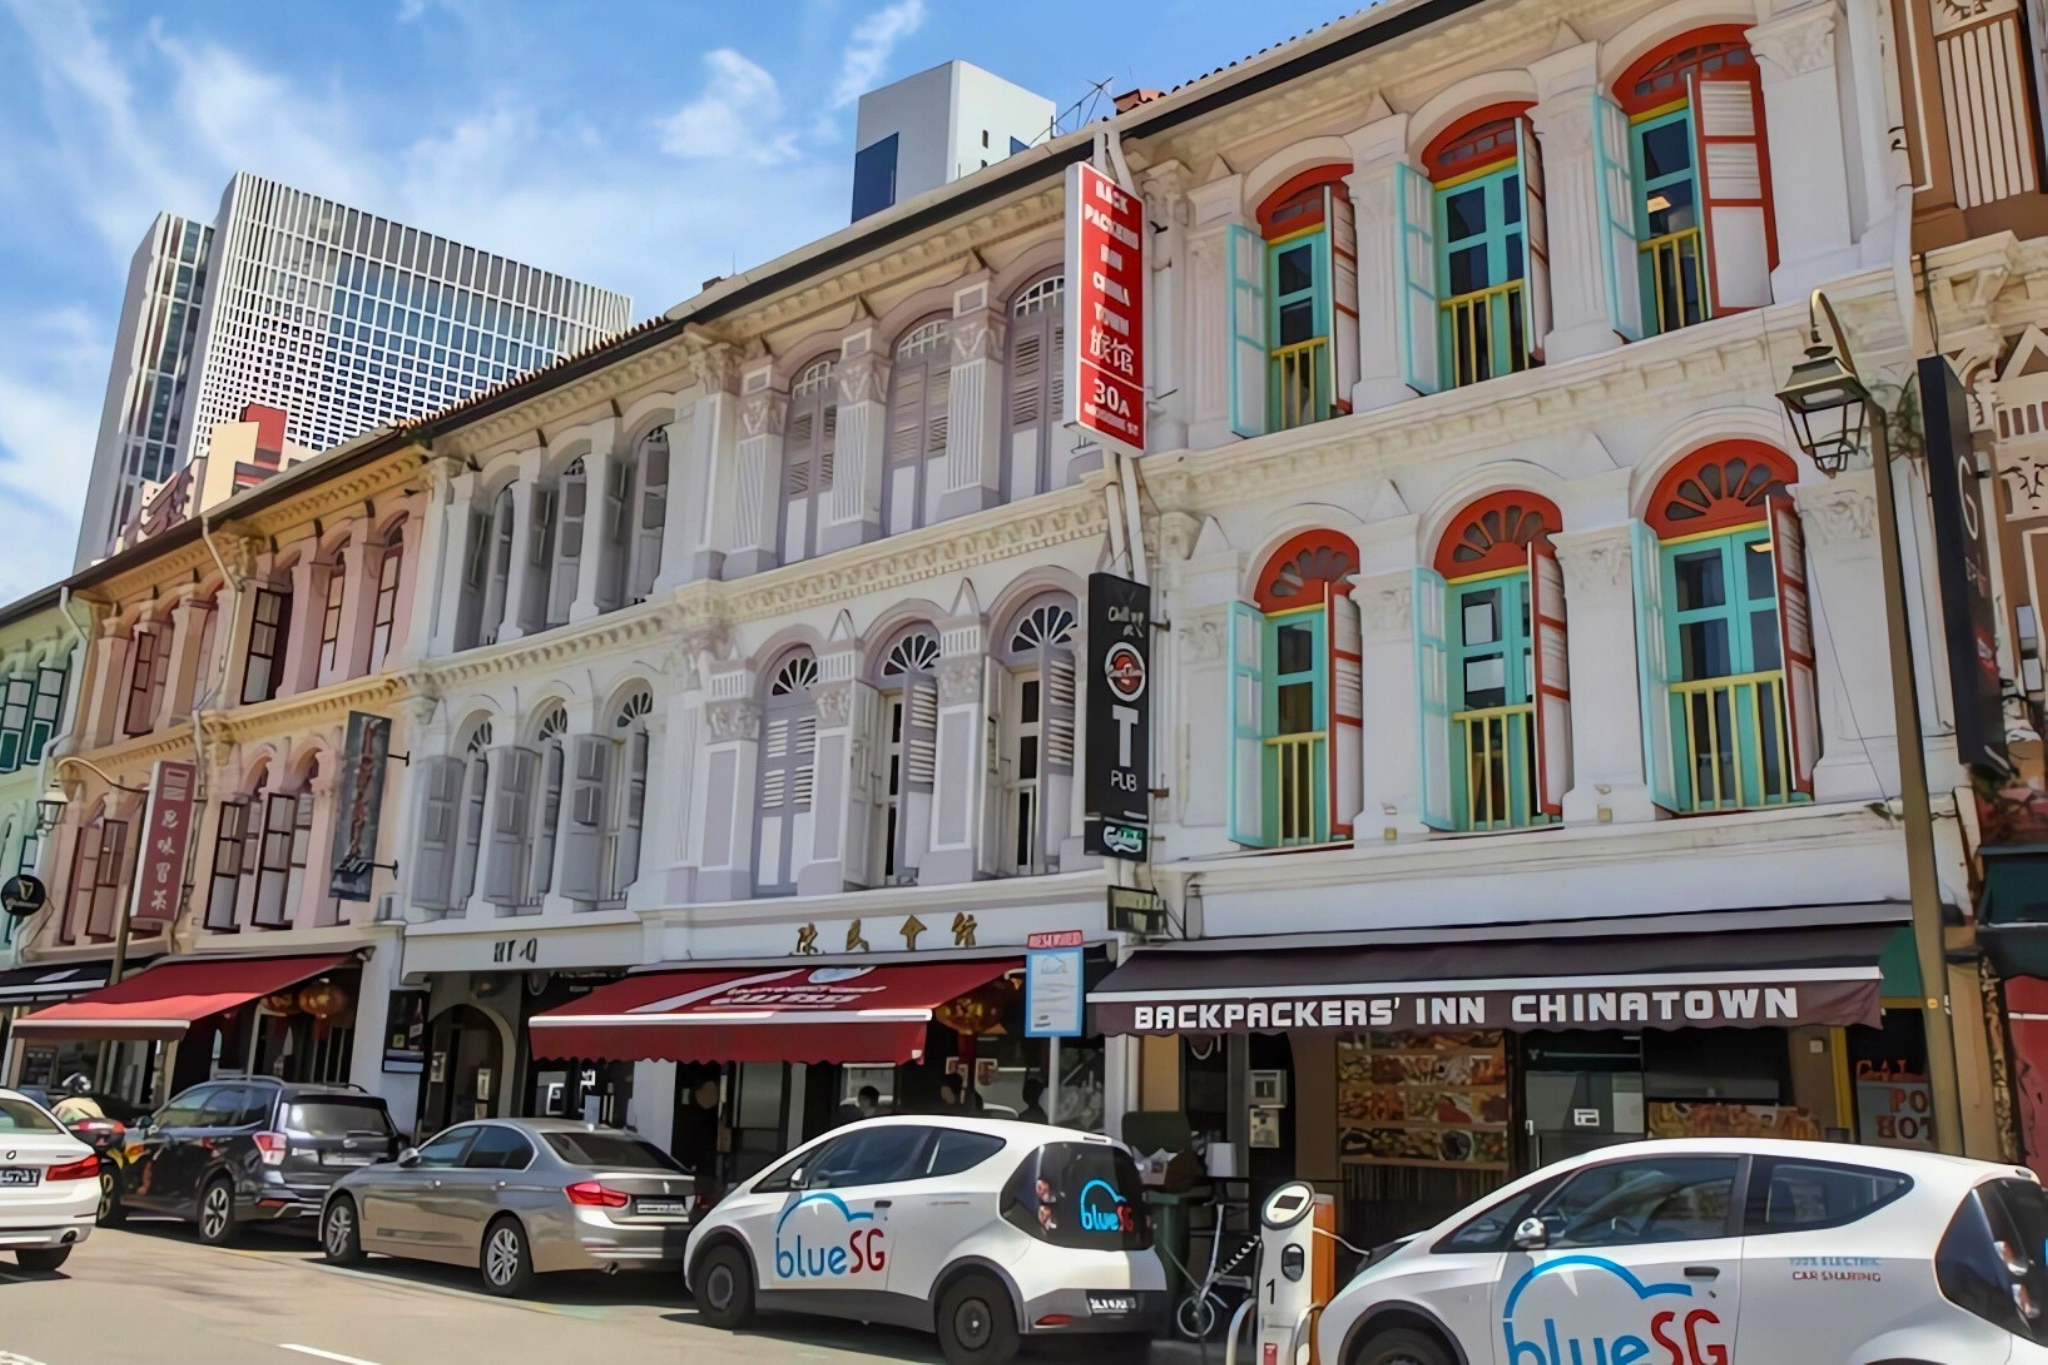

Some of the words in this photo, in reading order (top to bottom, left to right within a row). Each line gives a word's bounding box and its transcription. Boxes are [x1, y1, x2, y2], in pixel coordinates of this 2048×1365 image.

[1093, 377, 1131, 418] 30A
[1110, 769, 1138, 792] PUB
[1134, 997, 1401, 1030] BACKPACKERS'
[1416, 994, 1485, 1025] INN
[1511, 987, 1799, 1023] CHINATOWN
[1080, 1204, 1134, 1231] blueSG
[775, 1227, 886, 1279] blueSG
[1265, 1278, 1276, 1306] 1
